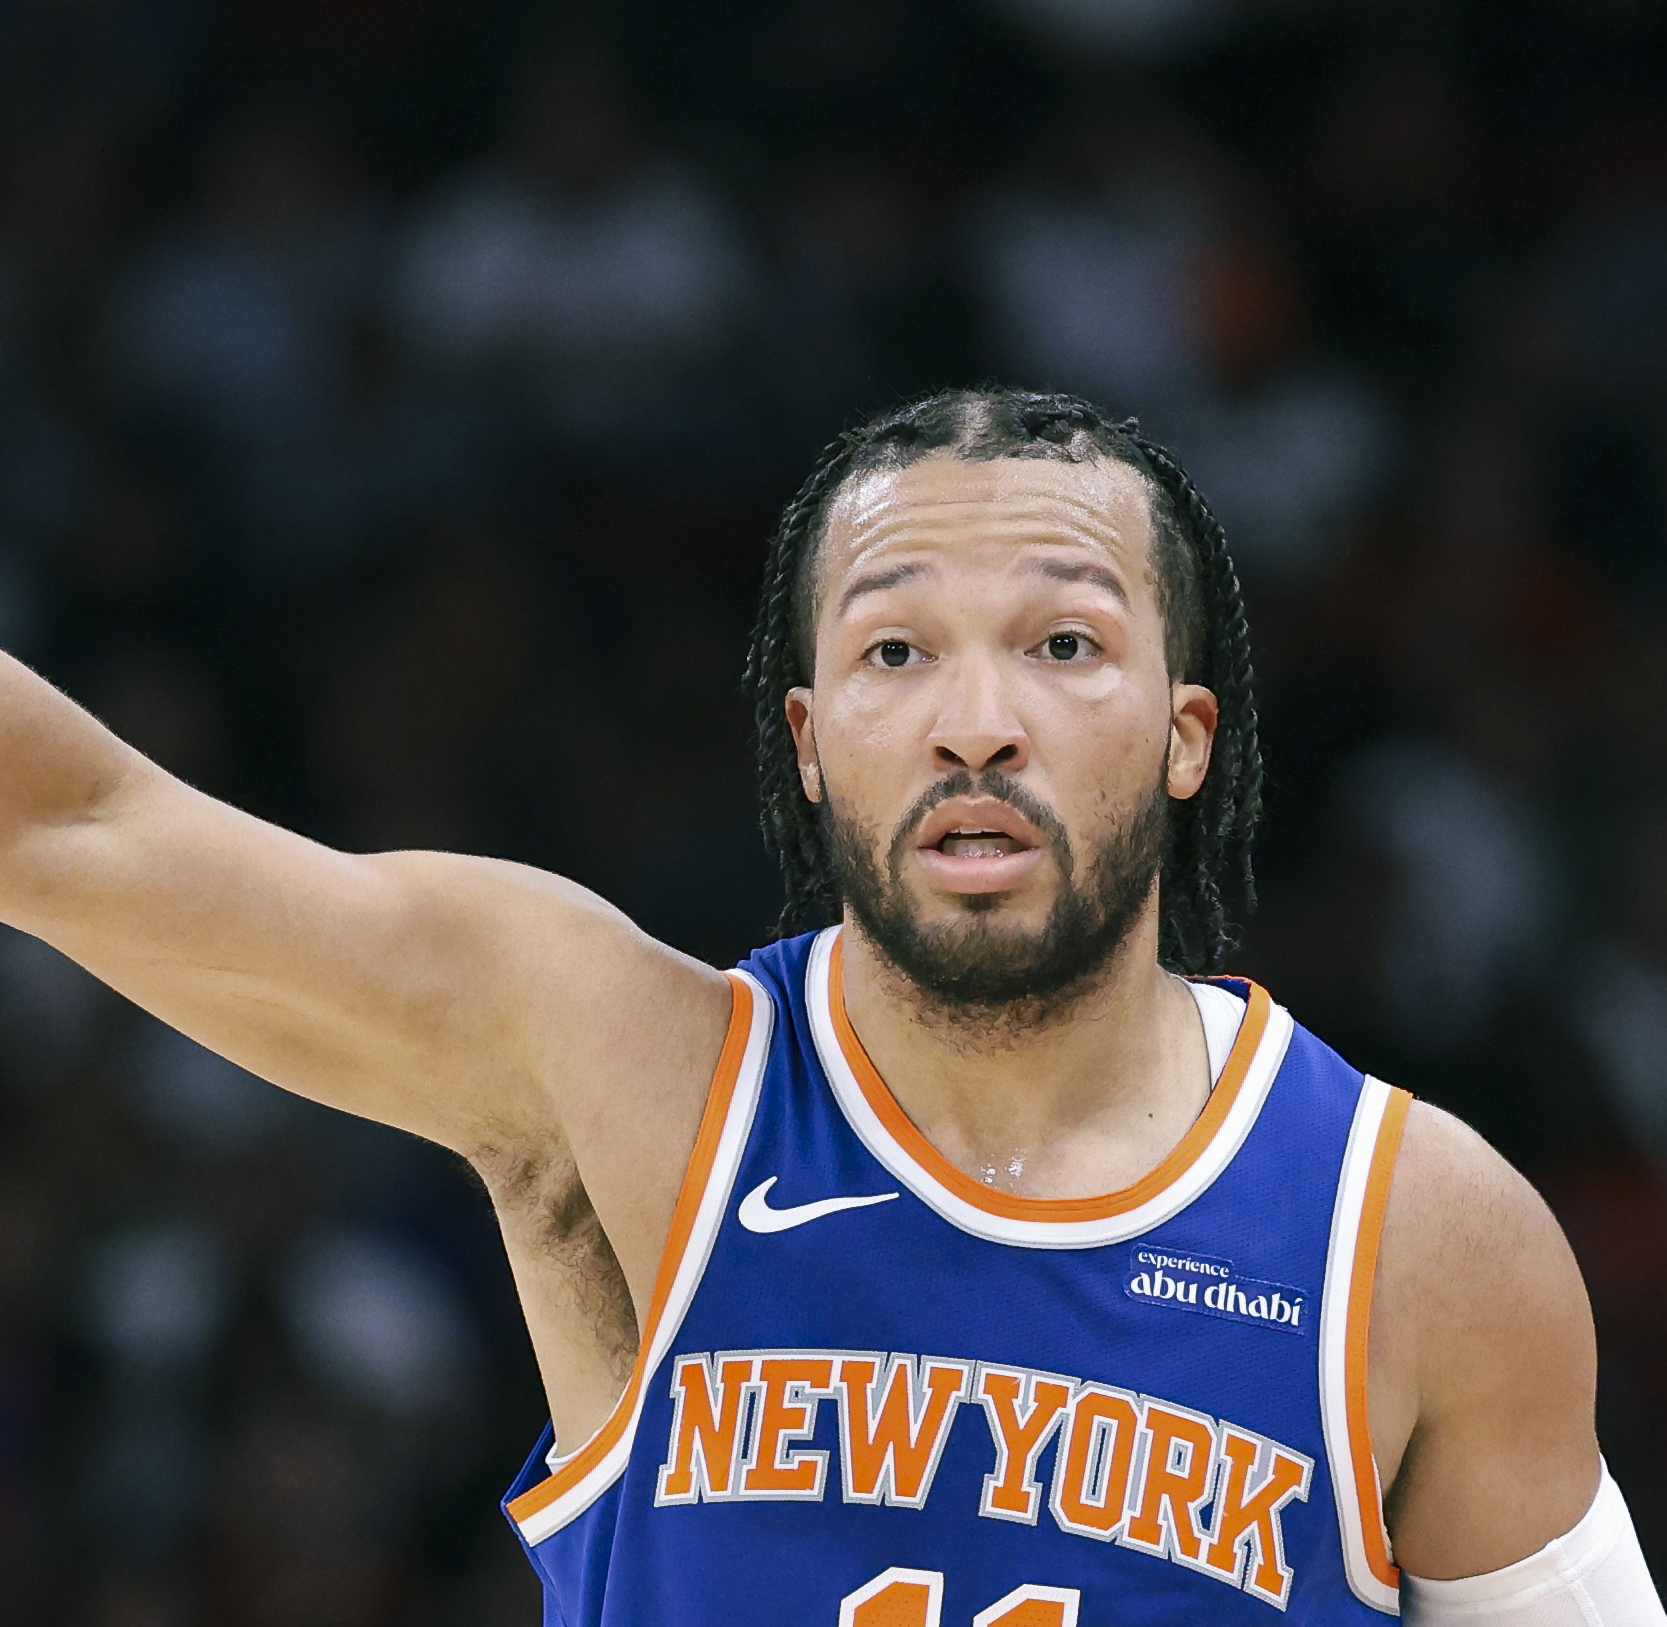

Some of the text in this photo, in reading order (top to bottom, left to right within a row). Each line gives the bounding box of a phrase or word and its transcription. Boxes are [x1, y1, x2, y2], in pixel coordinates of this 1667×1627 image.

[1137, 1250, 1230, 1278] experience
[1129, 1269, 1305, 1327] abu dhabi
[654, 1348, 1315, 1611] NEW YORK
